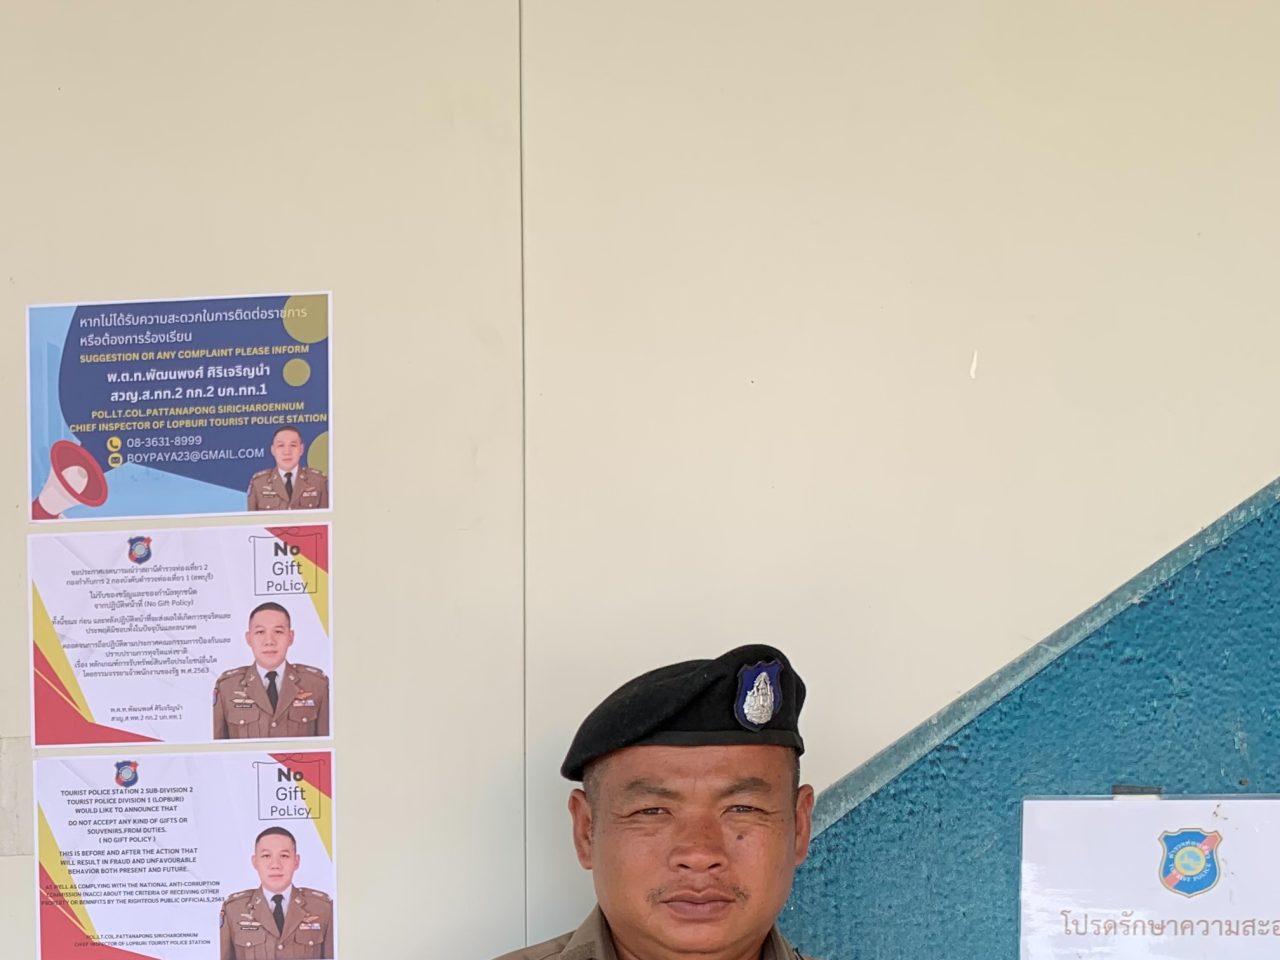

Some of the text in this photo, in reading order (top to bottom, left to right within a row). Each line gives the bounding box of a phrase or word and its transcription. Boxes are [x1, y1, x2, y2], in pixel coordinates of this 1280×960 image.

[80, 308, 307, 328] หากไม่ได้รับความสะดวกในการติดต่อราชการ
[80, 331, 192, 346] หรือต้องการร้องเรียน
[80, 345, 309, 363] SUGGESTION OR ANY COMPLAINT PLEASE INFORM
[107, 364, 270, 383] พ.ต.ท.พัฒนพงศ์ ศิริเจริญนำ
[186, 387, 214, 398] กก.2
[218, 384, 268, 397] บก.ทท.1
[218, 402, 304, 414] SIRICHAROENNUM
[70, 414, 327, 432] CHIEF INSPECTOR OF LOPBURI TOURIST POLICE STATION
[127, 436, 202, 448] 08-3631-8999
[127, 448, 264, 463] BOYPAYA23@GMAIL.COM
[274, 542, 300, 556] No
[272, 562, 302, 576] Gift
[278, 767, 304, 782] No
[276, 787, 306, 801] Gift
